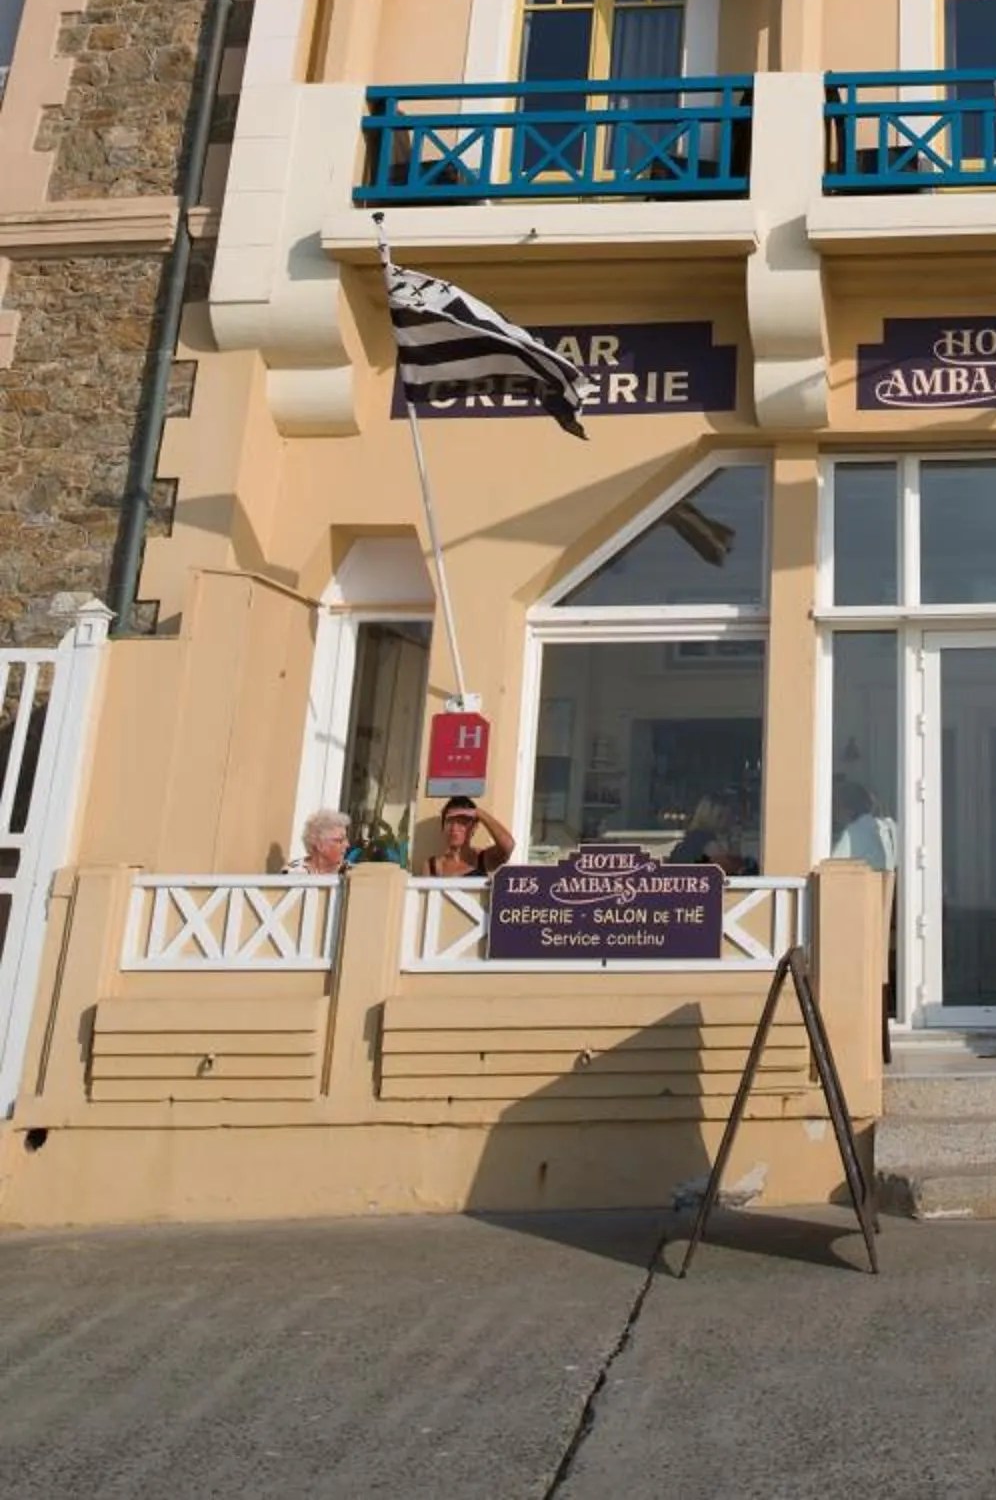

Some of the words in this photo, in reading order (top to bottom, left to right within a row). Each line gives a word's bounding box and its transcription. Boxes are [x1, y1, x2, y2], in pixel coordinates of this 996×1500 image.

[535, 334, 620, 368] AR
[458, 725, 482, 749] H
[575, 852, 642, 874] HOTEL
[507, 877, 539, 894] LES
[550, 876, 710, 902] AMBASSADEURS
[593, 908, 647, 924] SALON
[541, 927, 600, 946] Service
[606, 929, 665, 946] continu
